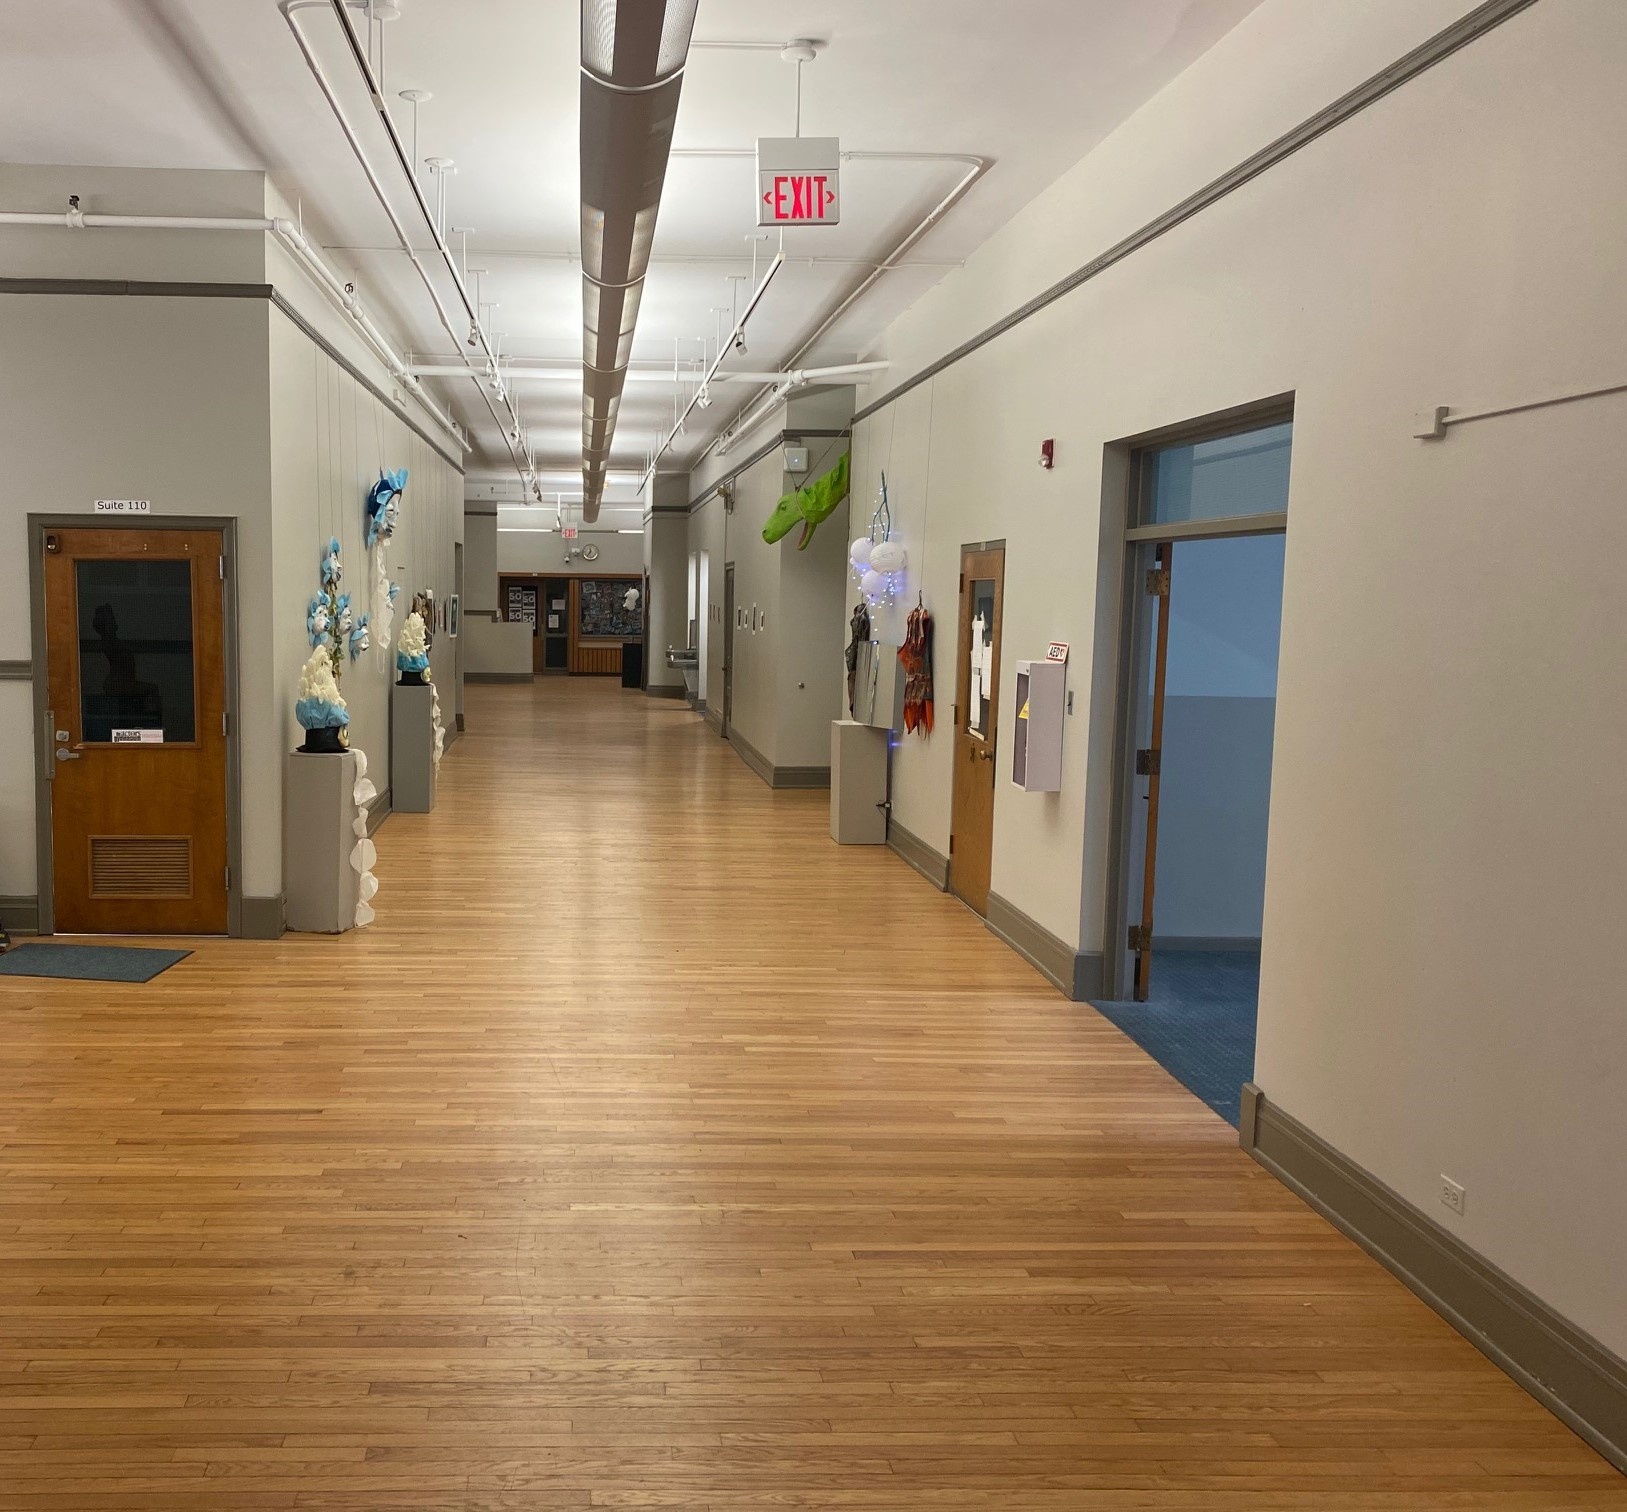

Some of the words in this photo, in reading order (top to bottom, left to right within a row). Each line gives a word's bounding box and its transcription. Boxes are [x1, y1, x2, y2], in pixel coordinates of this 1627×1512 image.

[774, 176, 828, 219] EXIT
[97, 500, 124, 510] Suite
[128, 501, 147, 510] 110
[565, 528, 576, 538] EXIT
[1049, 646, 1060, 658] AED
